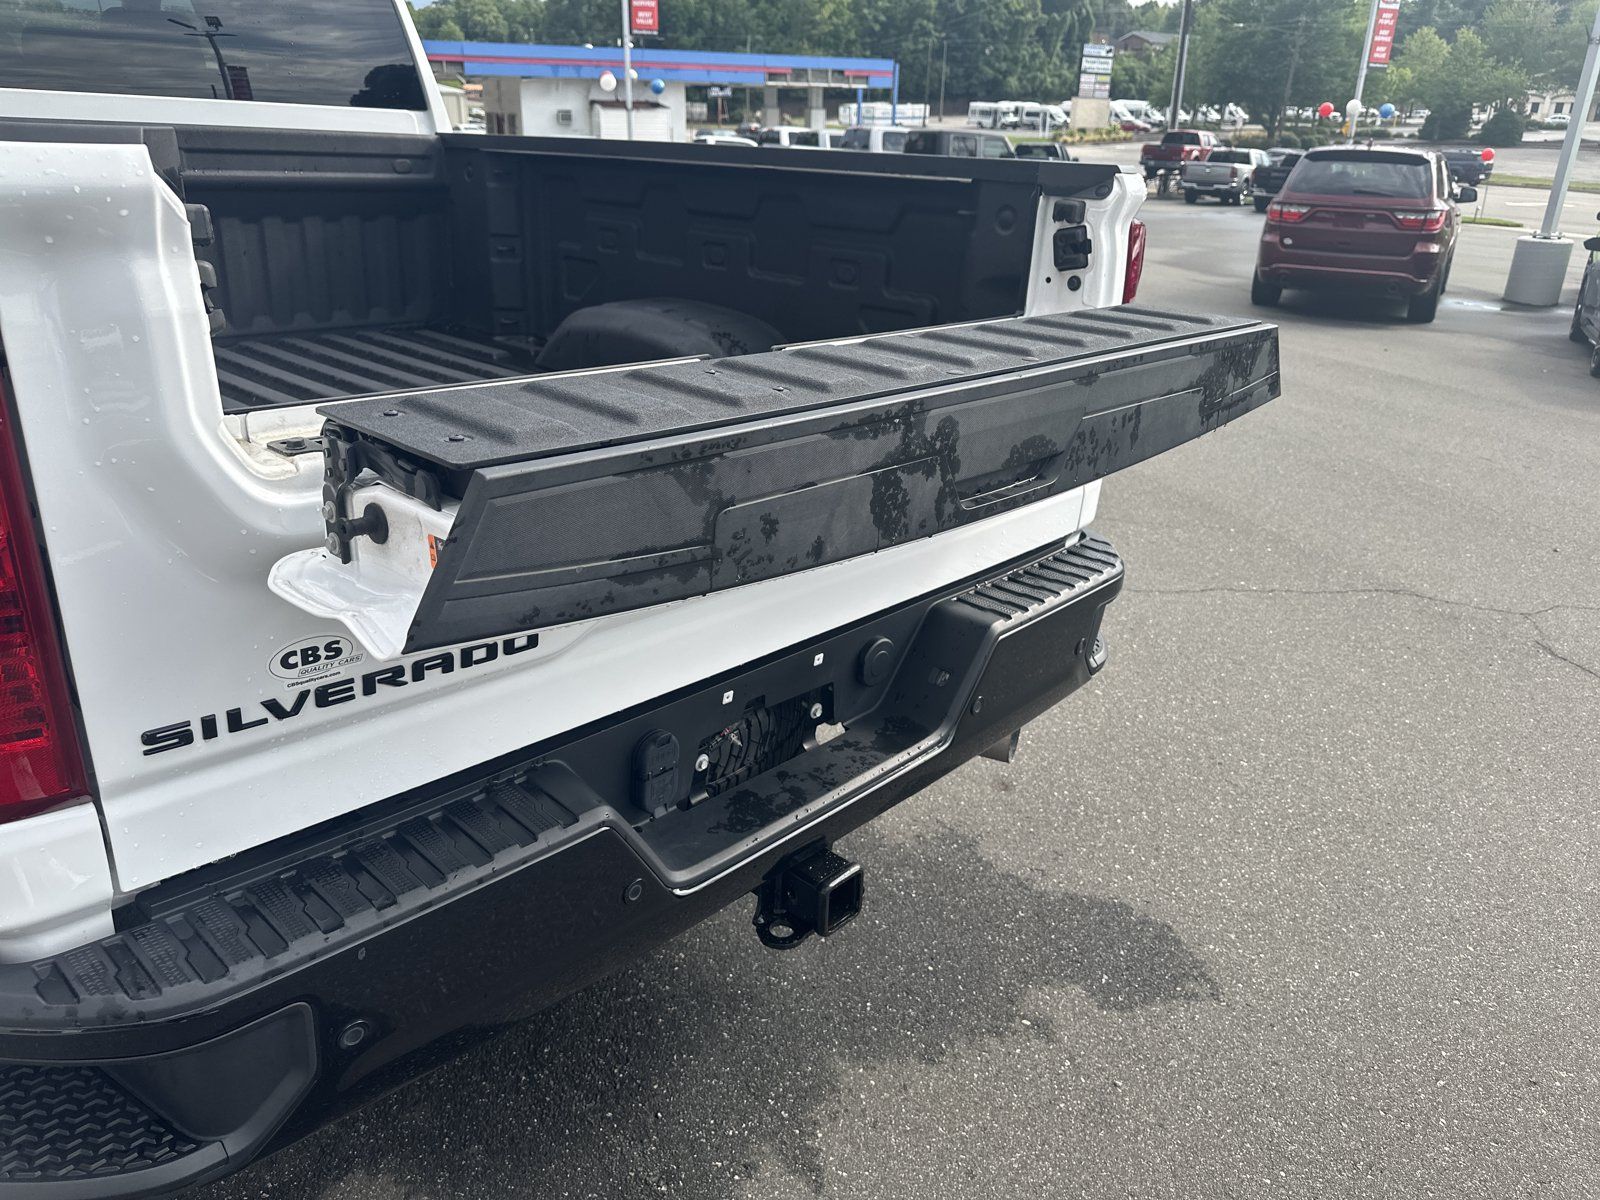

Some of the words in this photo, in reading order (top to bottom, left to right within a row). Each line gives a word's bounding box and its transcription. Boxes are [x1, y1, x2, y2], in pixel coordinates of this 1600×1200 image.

[280, 639, 343, 670] CBS
[300, 661, 335, 675] QUALITY
[338, 655, 360, 666] CARS
[286, 671, 341, 688] CBSqualitycars.com
[141, 632, 539, 756] SILVERADO
